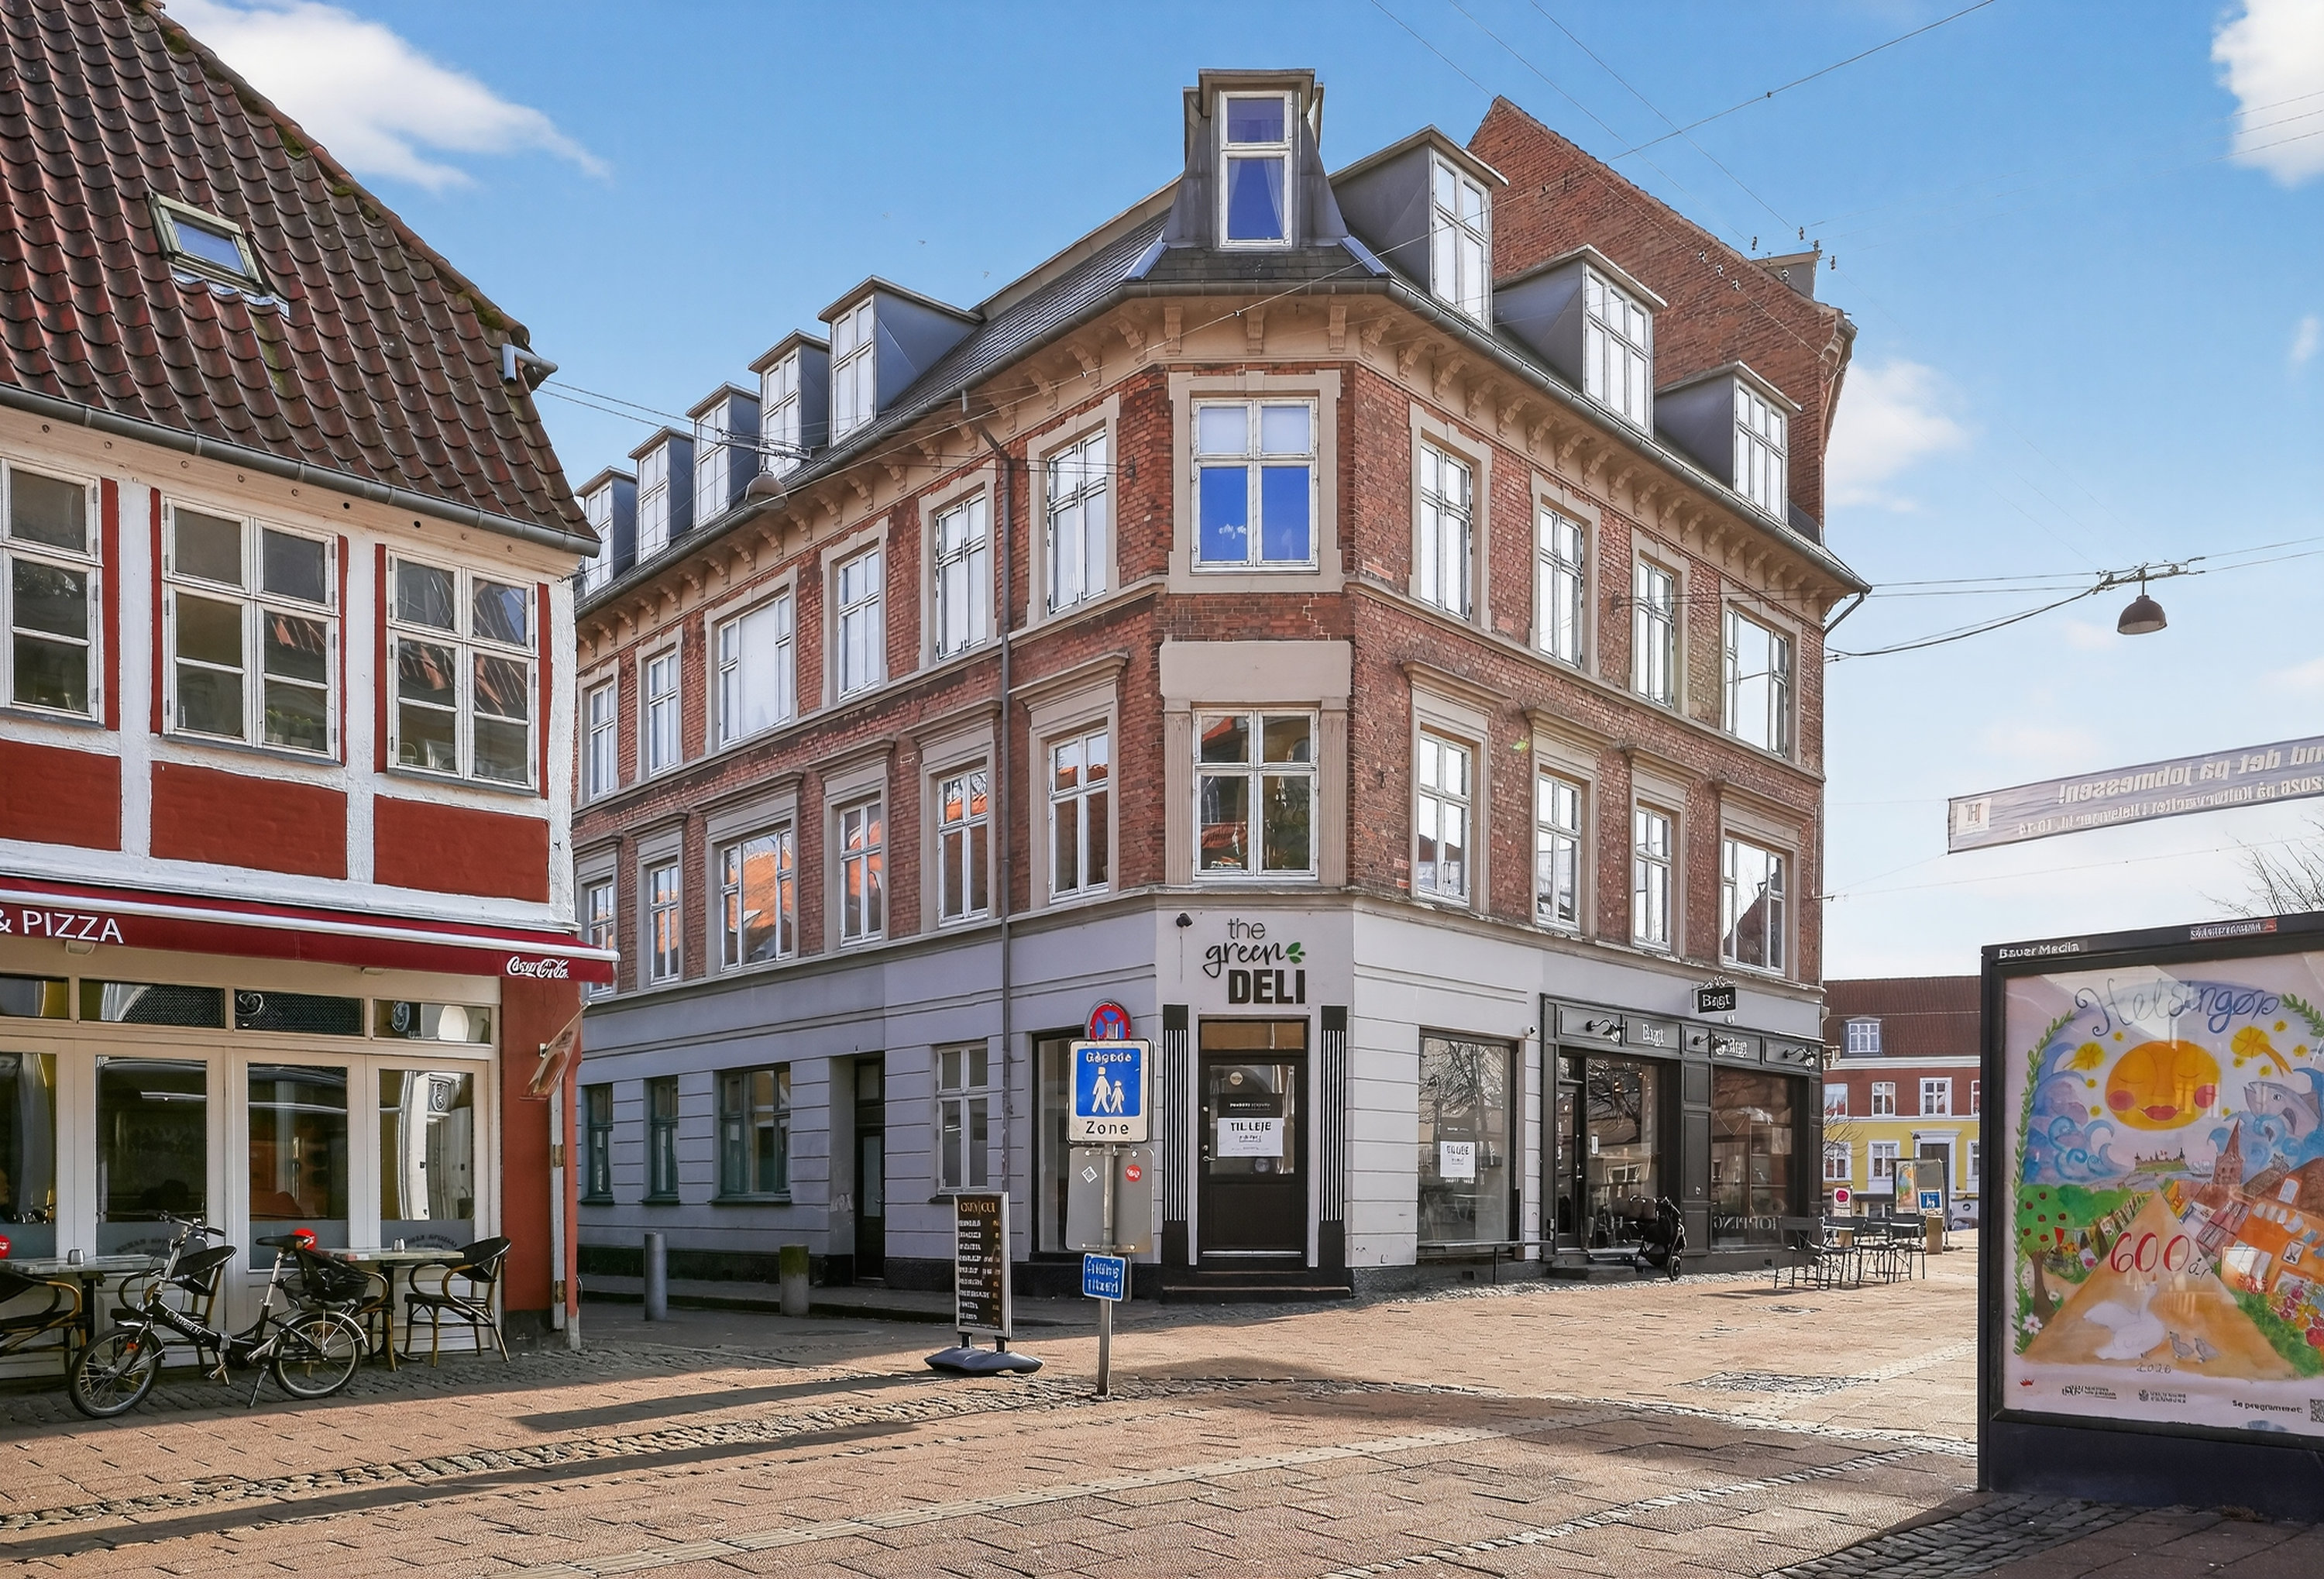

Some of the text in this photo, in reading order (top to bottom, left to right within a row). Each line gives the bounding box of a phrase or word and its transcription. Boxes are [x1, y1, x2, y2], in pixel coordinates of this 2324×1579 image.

[22, 910, 124, 944] PIZZA
[1227, 917, 1266, 940] the
[1202, 941, 1286, 979] green
[1228, 968, 1306, 1005] DELI
[1085, 1120, 1129, 1135] Zone
[2110, 1232, 2191, 1273] 600
